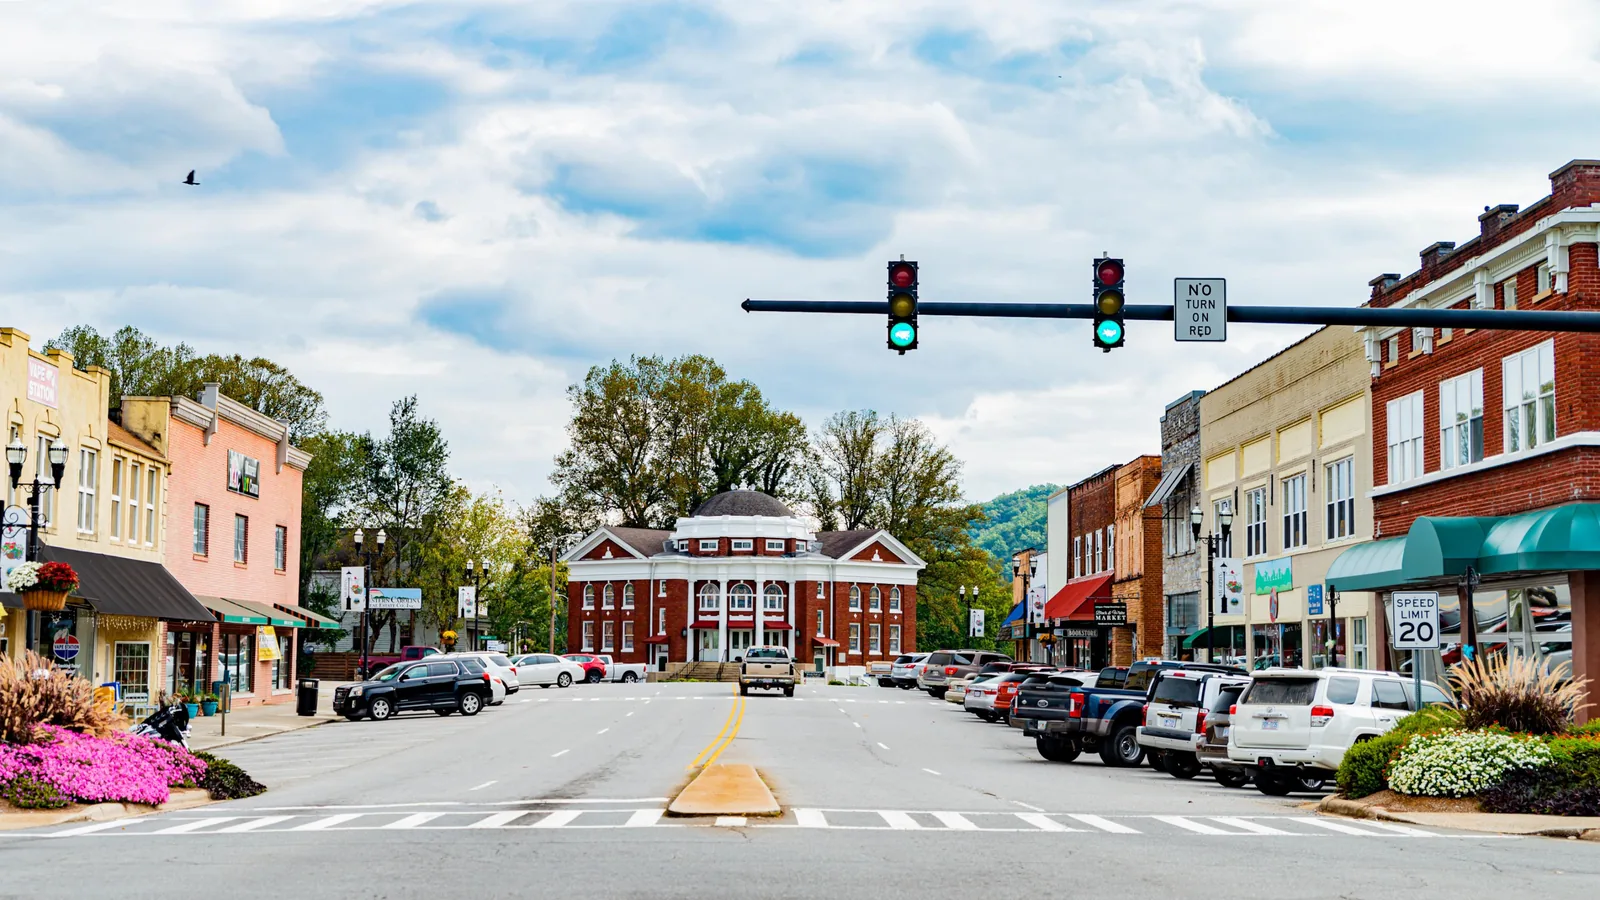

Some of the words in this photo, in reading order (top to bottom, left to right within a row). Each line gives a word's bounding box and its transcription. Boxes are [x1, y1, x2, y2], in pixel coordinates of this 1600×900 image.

[1189, 284, 1212, 296] NO
[1185, 299, 1216, 309] TURN
[1192, 312, 1209, 323] ON
[1189, 325, 1212, 336] RED
[30, 361, 46, 382] VAPE
[29, 379, 55, 403] STATION
[1396, 598, 1435, 608] SPEED
[1401, 610, 1430, 619] LIMIT
[1399, 621, 1434, 642] 20
